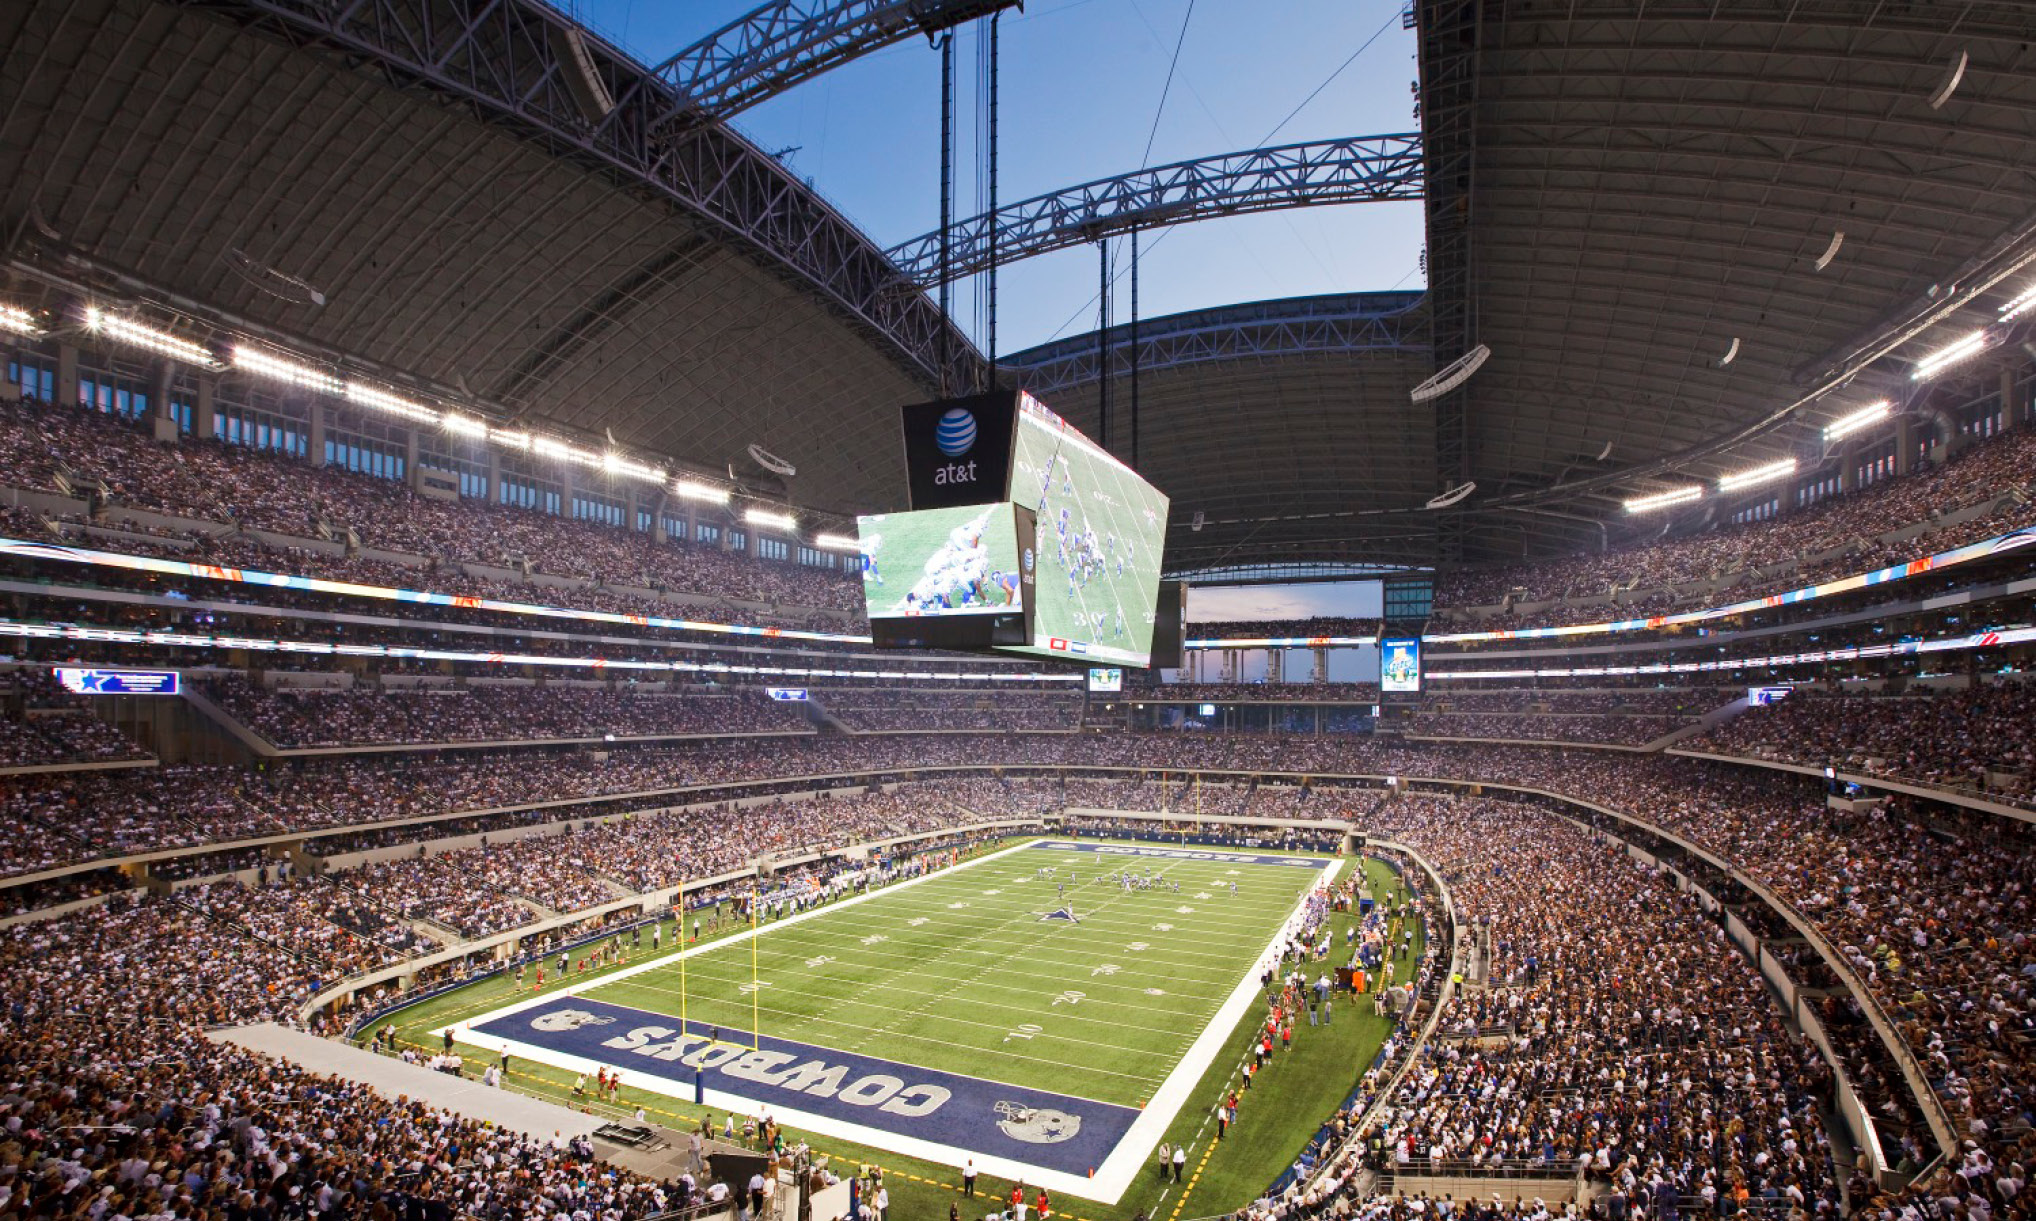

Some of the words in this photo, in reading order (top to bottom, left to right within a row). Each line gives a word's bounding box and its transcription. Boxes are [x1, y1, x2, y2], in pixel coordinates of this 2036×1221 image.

[934, 460, 977, 485] at&t
[1009, 1024, 1043, 1040] 10
[601, 1026, 952, 1117] COWBOYS
